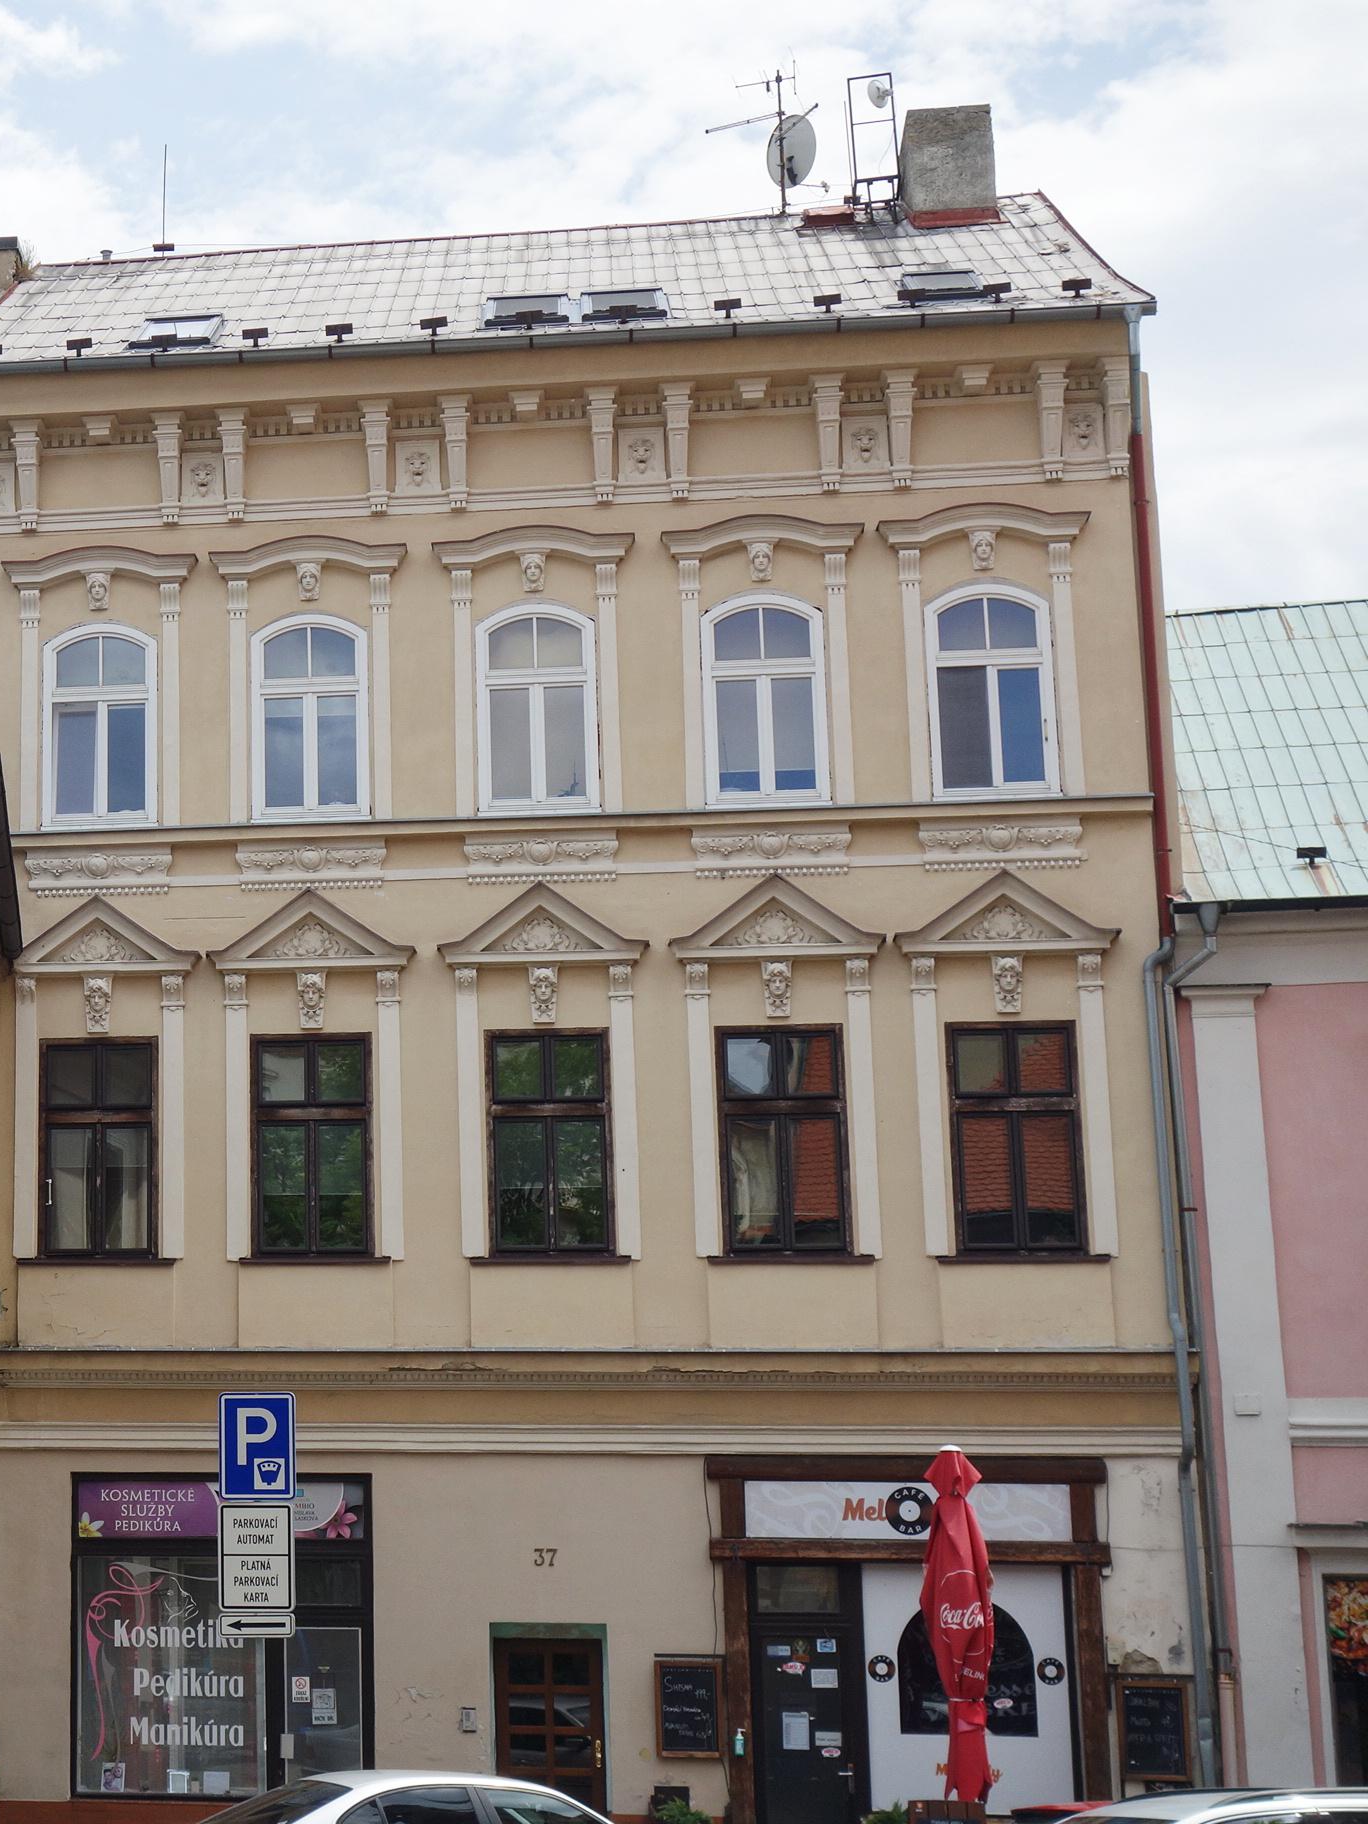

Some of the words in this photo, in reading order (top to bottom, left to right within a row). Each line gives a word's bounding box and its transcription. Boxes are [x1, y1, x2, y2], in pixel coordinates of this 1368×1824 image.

[237, 1407, 277, 1465] P
[101, 1487, 195, 1501] KOSMETICKÉ
[894, 1489, 925, 1500] CAFE
[121, 1503, 175, 1517] SLUŽBY
[115, 1518, 182, 1531] PEDIKÚRA
[233, 1516, 278, 1530] PARKOVACÍ
[899, 1525, 922, 1533] BAR
[236, 1534, 275, 1545] AUTOMAT
[240, 1558, 271, 1571] PLATNÁ
[534, 1548, 558, 1567] 37
[233, 1573, 279, 1587] PARKOVACÍ
[243, 1592, 269, 1602] KARTA
[133, 1668, 244, 1697] Pedikúra
[130, 1716, 244, 1746] Manikúra
